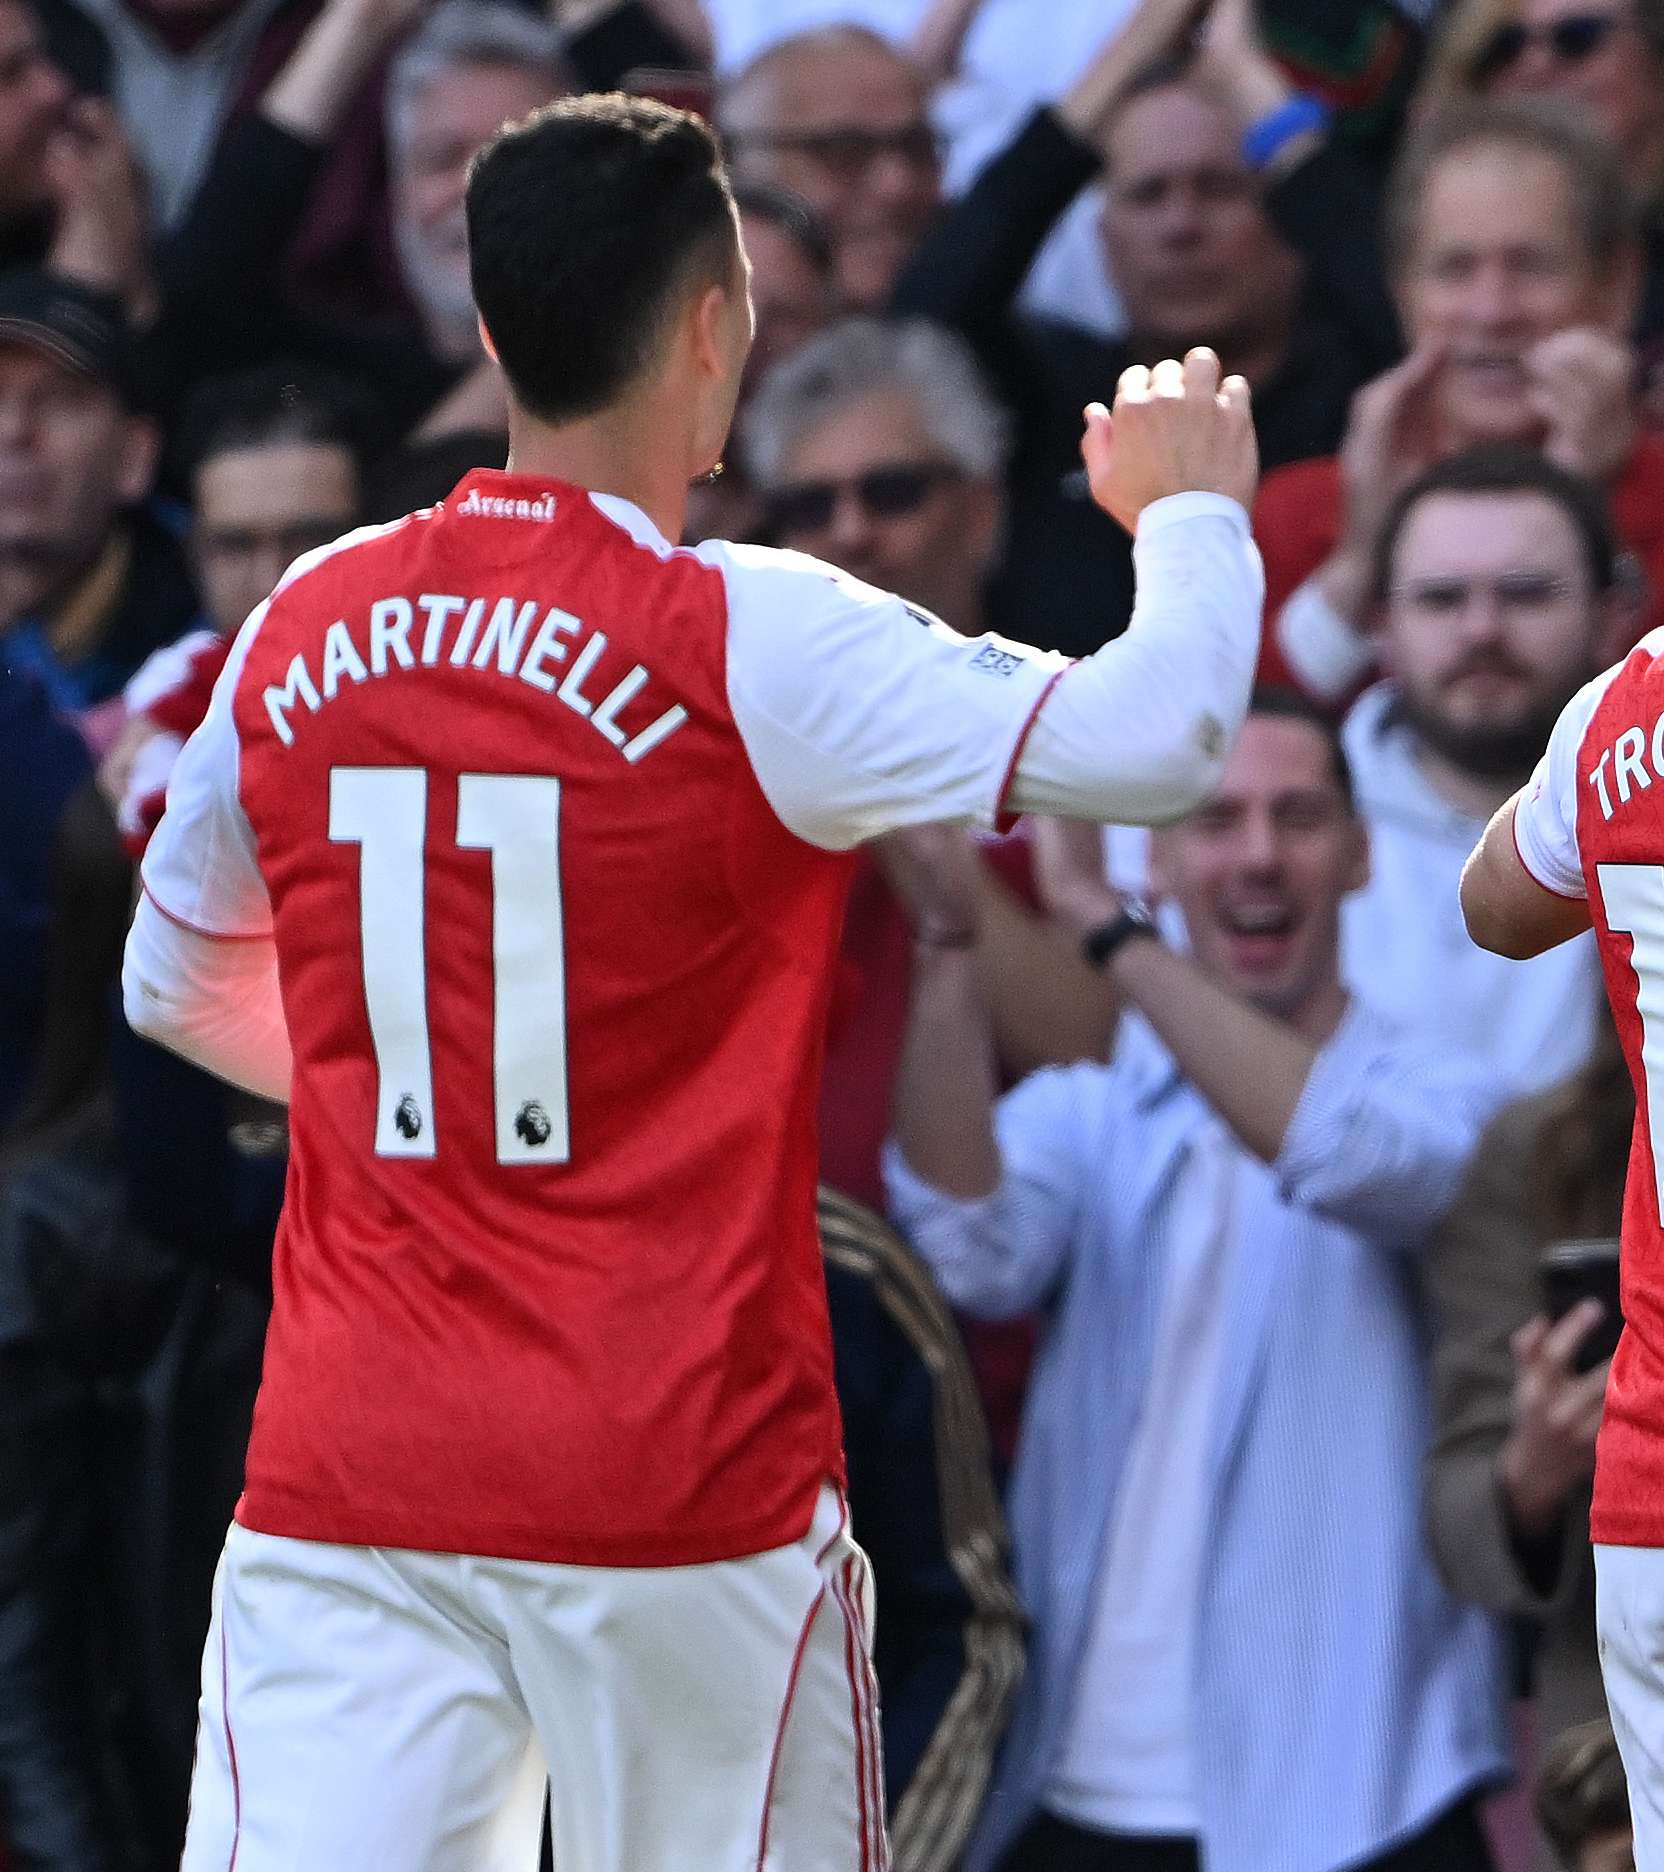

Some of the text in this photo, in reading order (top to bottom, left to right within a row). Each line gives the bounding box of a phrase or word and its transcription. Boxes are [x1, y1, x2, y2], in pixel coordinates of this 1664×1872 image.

[457, 488, 557, 522] Arsenal
[262, 593, 688, 764] MARTINELLI
[328, 764, 570, 1165] 11
